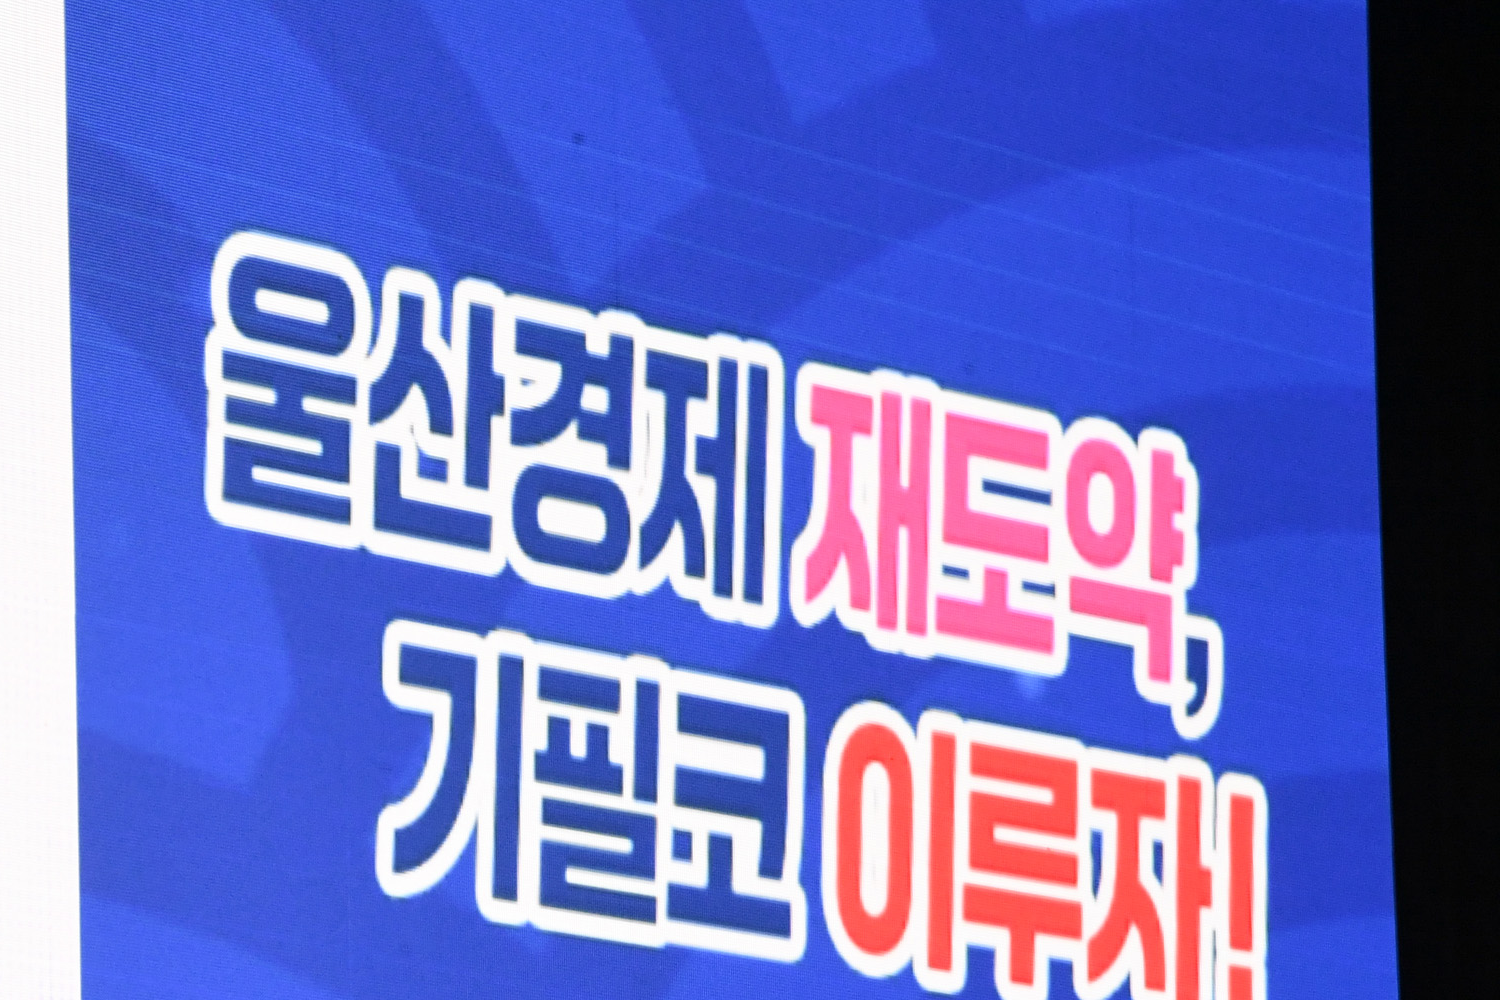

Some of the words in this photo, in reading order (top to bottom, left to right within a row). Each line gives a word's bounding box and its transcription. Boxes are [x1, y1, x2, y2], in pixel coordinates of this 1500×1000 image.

[208, 231, 781, 625] 울산경제
[791, 364, 1223, 738] 재도약,
[376, 620, 805, 961] 기필코
